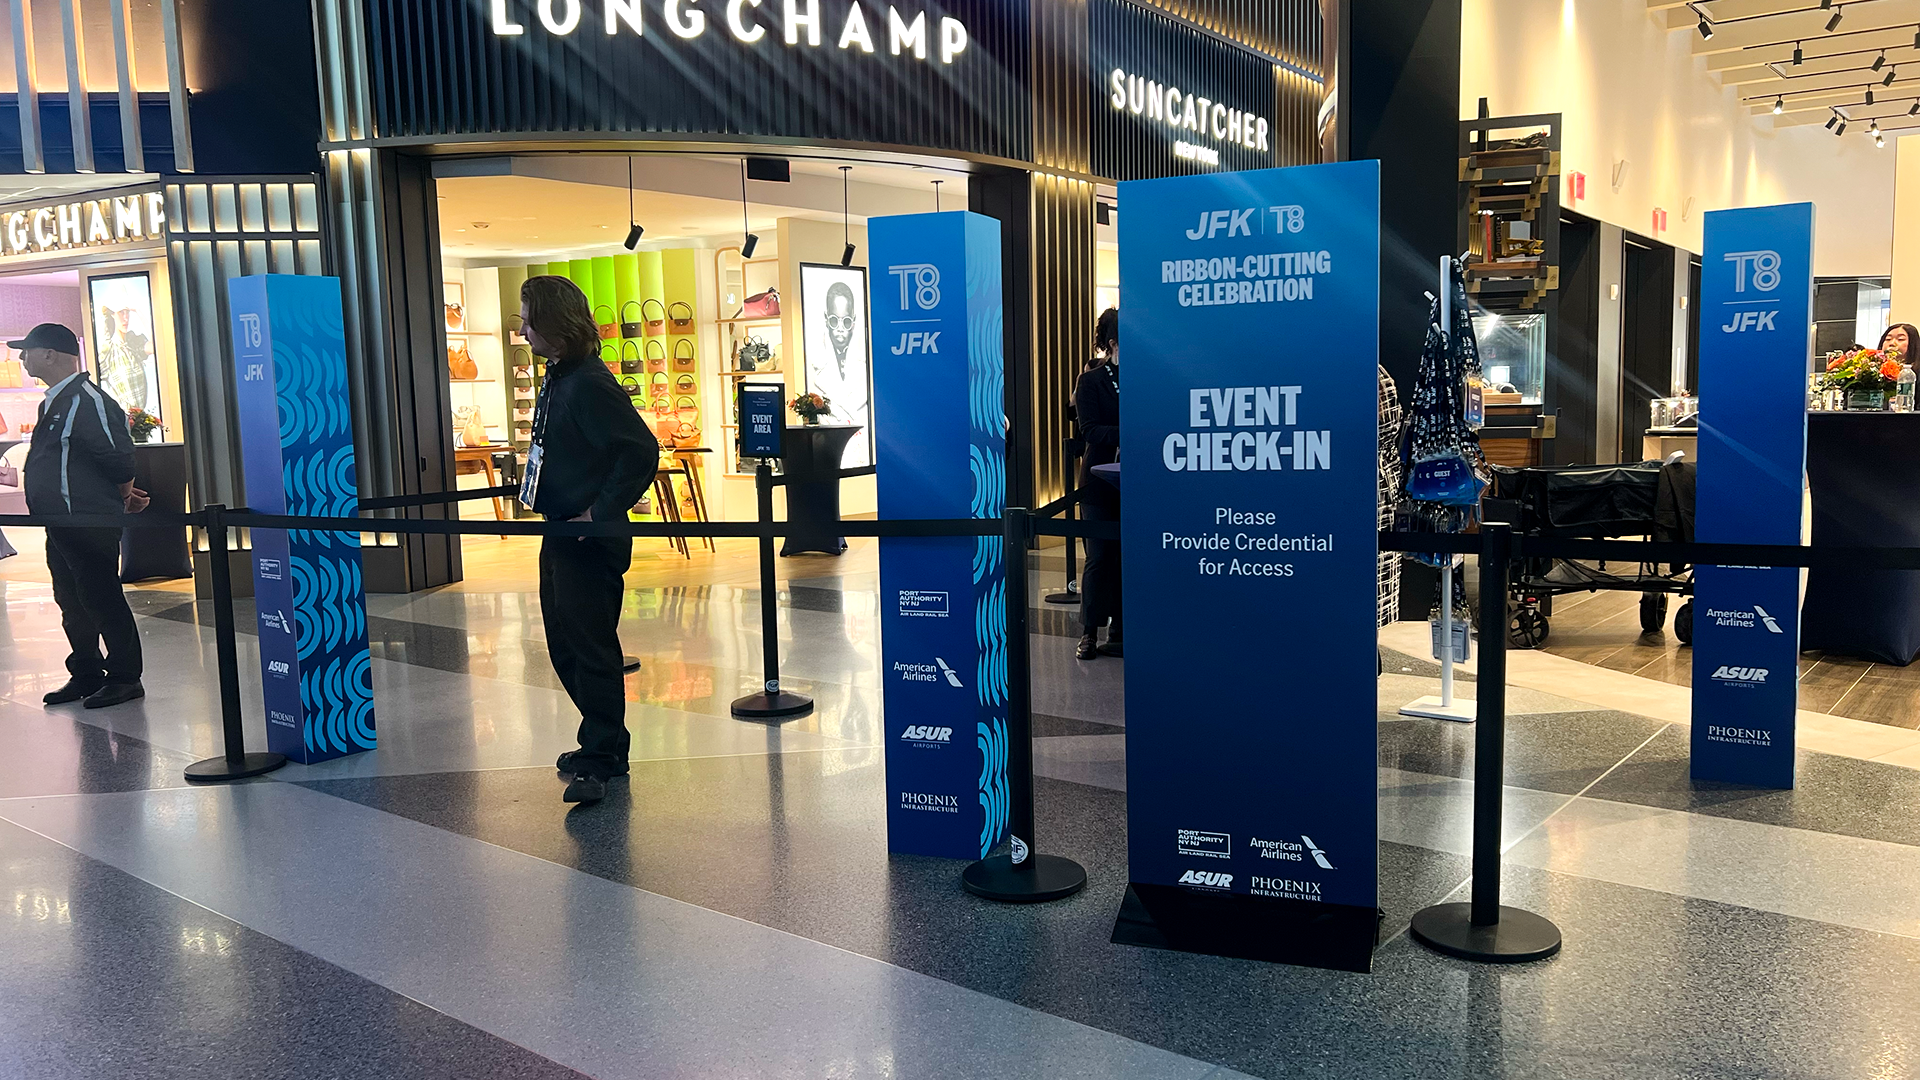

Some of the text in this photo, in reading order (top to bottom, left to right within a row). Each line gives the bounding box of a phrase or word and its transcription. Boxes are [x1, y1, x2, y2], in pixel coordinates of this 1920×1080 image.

[491, 0, 968, 64] LONGCHAMP
[1112, 68, 1268, 151] SUNCATCHER
[1175, 140, 1196, 159] NEW
[0, 191, 165, 252] GCHAMP
[1186, 204, 1304, 240] JFK T8
[1162, 250, 1331, 284] RIBBON-CUTTING
[1724, 250, 1781, 292] T8
[888, 264, 940, 310] T8
[1178, 277, 1312, 307] CELEBRATION
[1722, 310, 1779, 333] JFK
[239, 313, 261, 348] T8
[891, 332, 941, 355] JFK
[244, 364, 264, 381] JFK
[1190, 386, 1302, 428] EVENT
[752, 414, 772, 423] EVENT
[754, 424, 771, 433] AREA
[1162, 430, 1330, 472] CHECK-IN
[1216, 507, 1276, 525] Please
[1162, 532, 1332, 552] Provide Credential
[1198, 558, 1294, 576] for Access
[1706, 608, 1754, 619] American
[1716, 618, 1754, 627] Airlines
[268, 660, 289, 674] ASUR
[894, 661, 936, 672] American
[1711, 666, 1769, 681] ASUR
[903, 671, 937, 682] Airlines
[271, 710, 295, 723] PHOENIX
[901, 725, 952, 741] ASUR
[1708, 736, 1771, 746] INFRASTRUCTURE
[1709, 725, 1771, 740] PHOENIX
[901, 792, 958, 806] PHOENIX
[901, 804, 958, 813] INFRASTRUCTURE
[1178, 834, 1224, 844] AUTHORITY
[1250, 837, 1302, 852] American
[1260, 848, 1302, 862] Airlines
[1178, 870, 1234, 888] ASUR
[1252, 876, 1321, 894] PHOENIX
[1250, 888, 1321, 902] INFRASTRUCTURE
